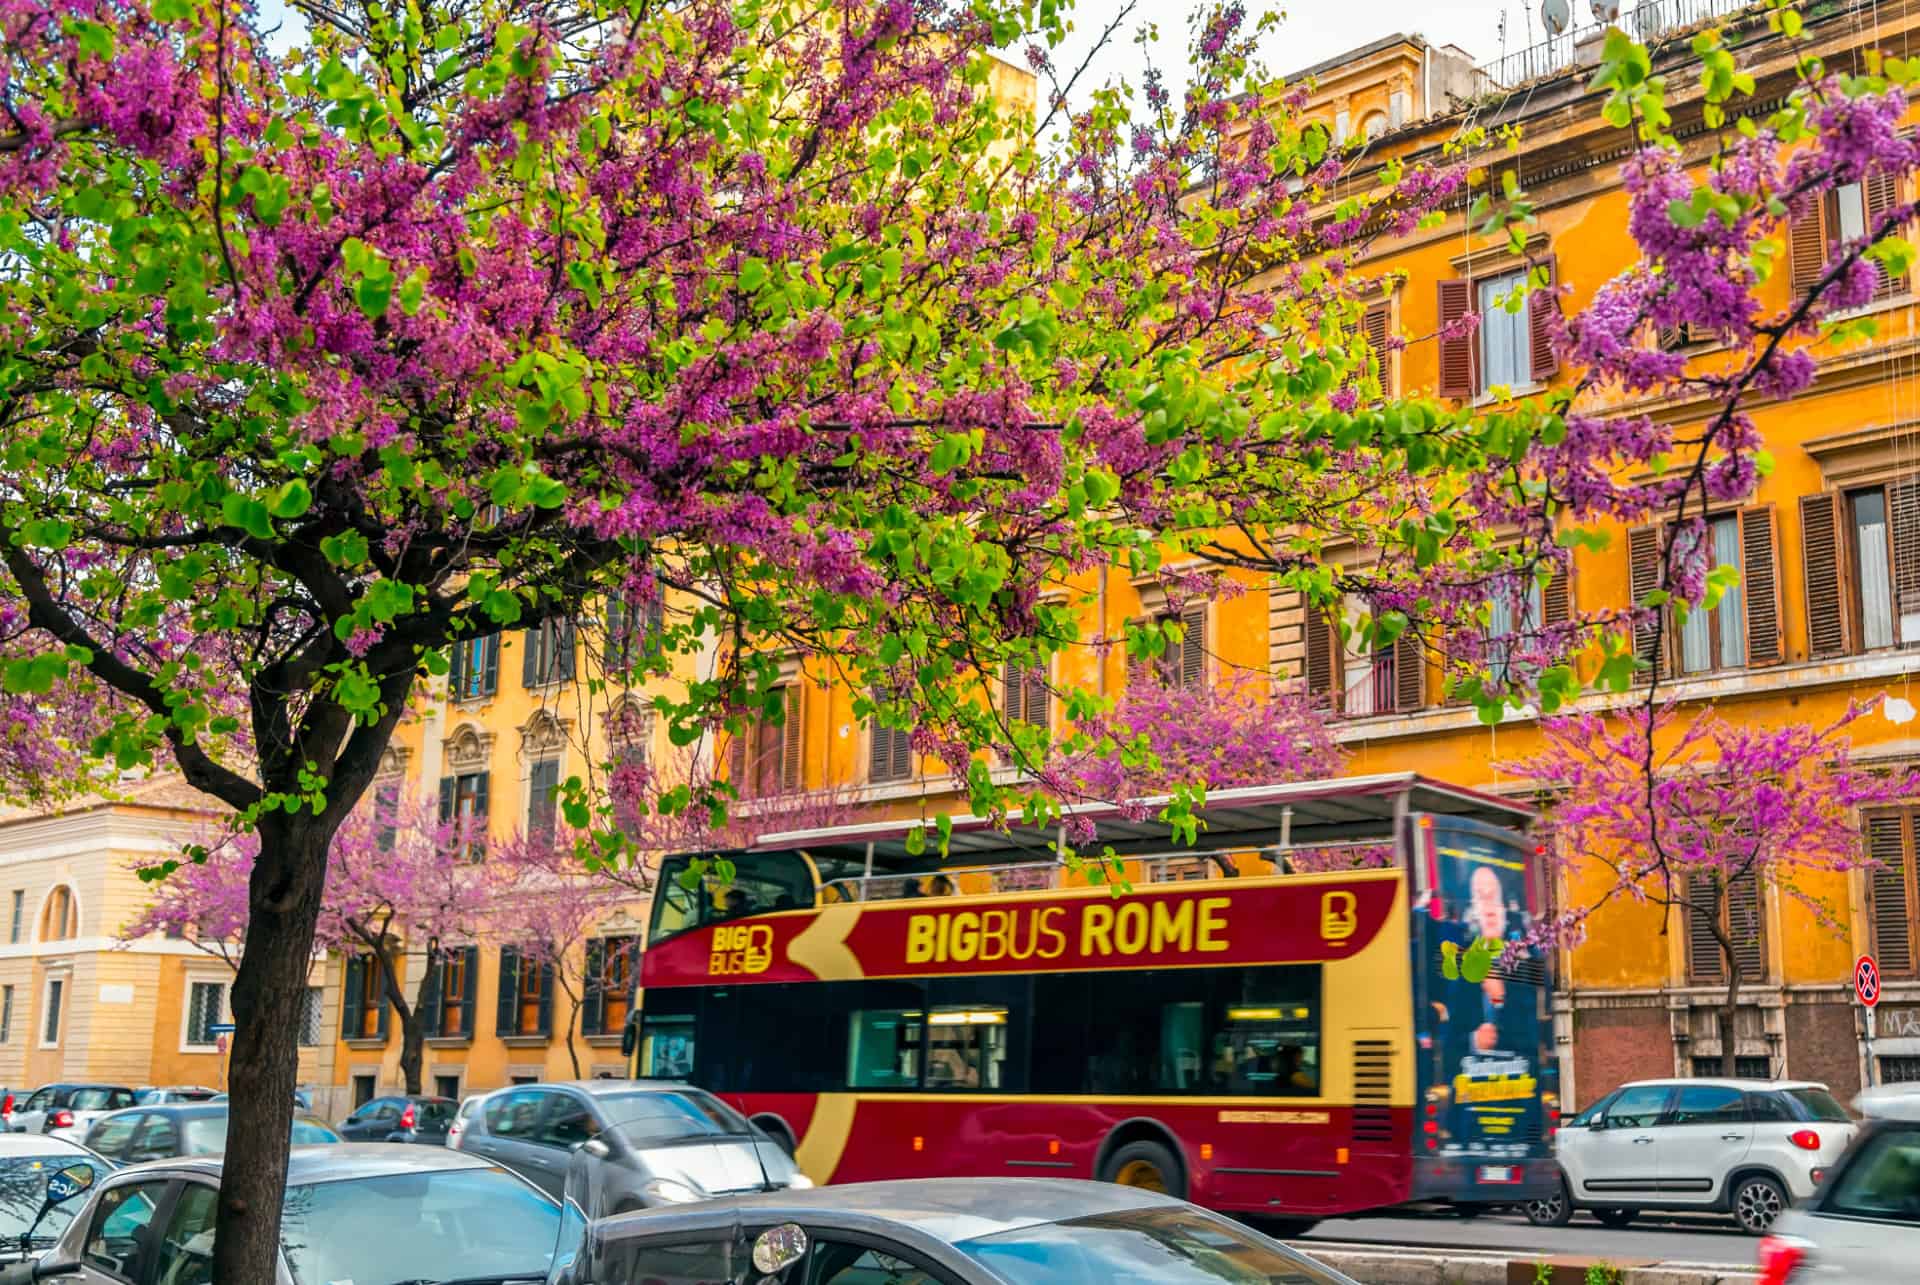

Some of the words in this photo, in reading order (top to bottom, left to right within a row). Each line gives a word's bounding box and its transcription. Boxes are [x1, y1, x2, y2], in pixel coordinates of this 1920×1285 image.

[712, 926, 748, 951] BIG
[1079, 897, 1232, 957] ROME
[708, 951, 745, 975] BUS
